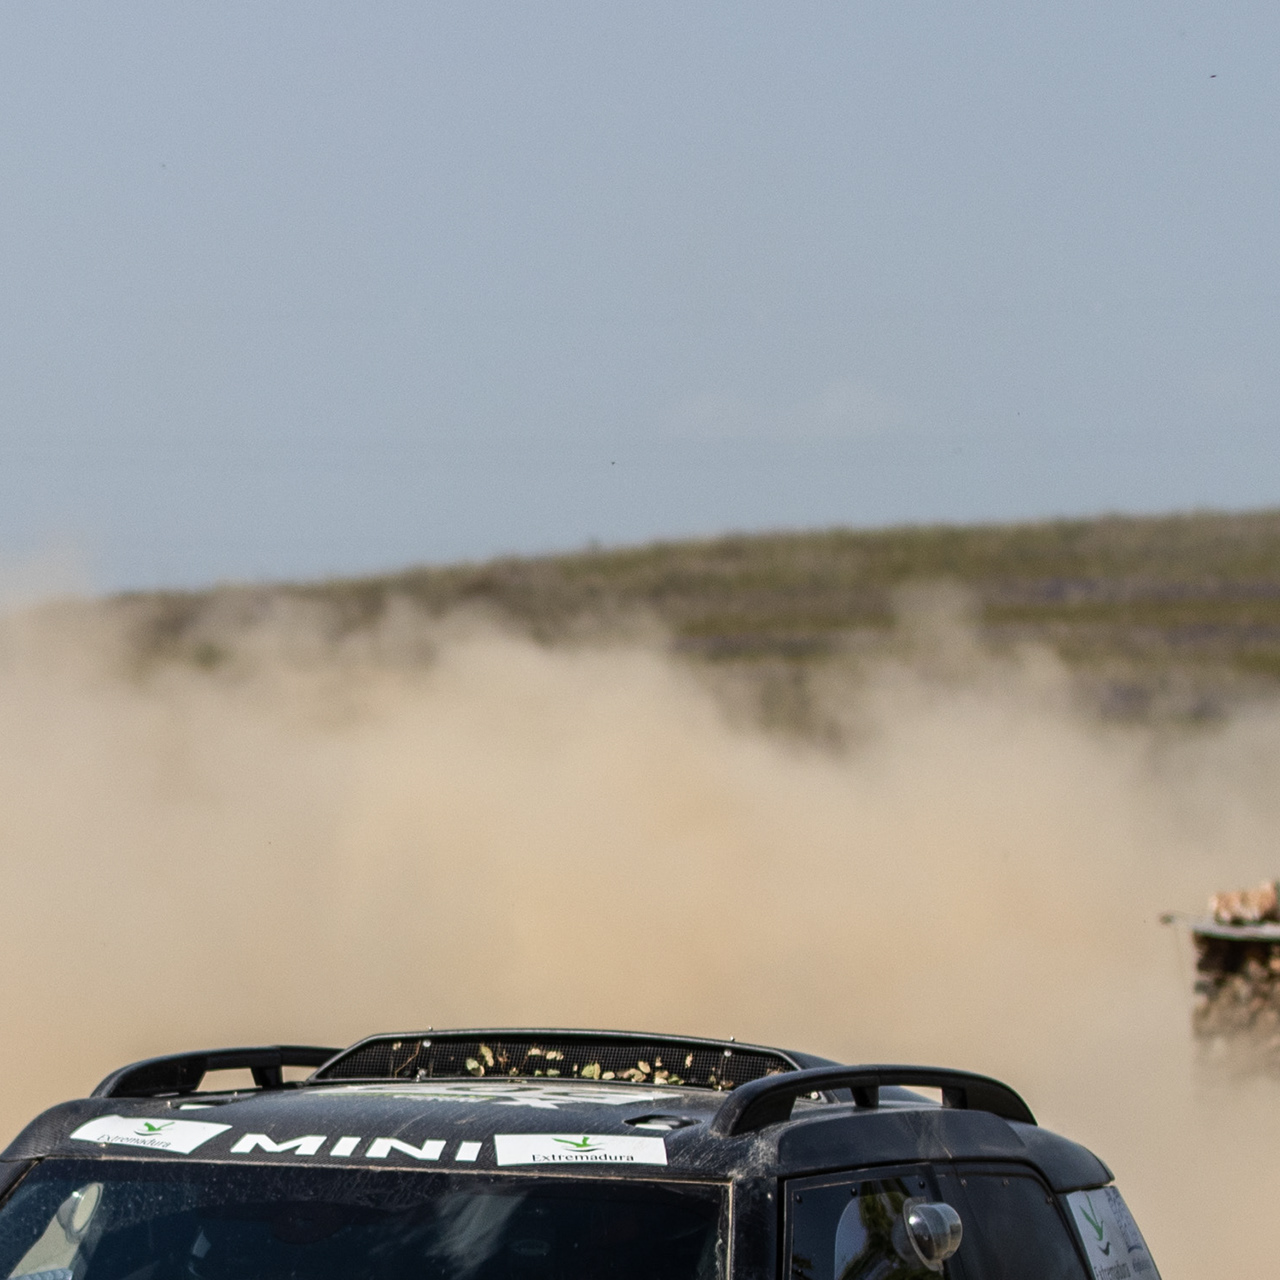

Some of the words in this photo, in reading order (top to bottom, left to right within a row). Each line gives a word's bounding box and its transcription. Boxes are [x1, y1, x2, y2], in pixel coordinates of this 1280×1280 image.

[96, 1133, 172, 1149] Extremadura
[230, 1133, 482, 1162] MINI
[531, 1153, 635, 1163] Extremadura
